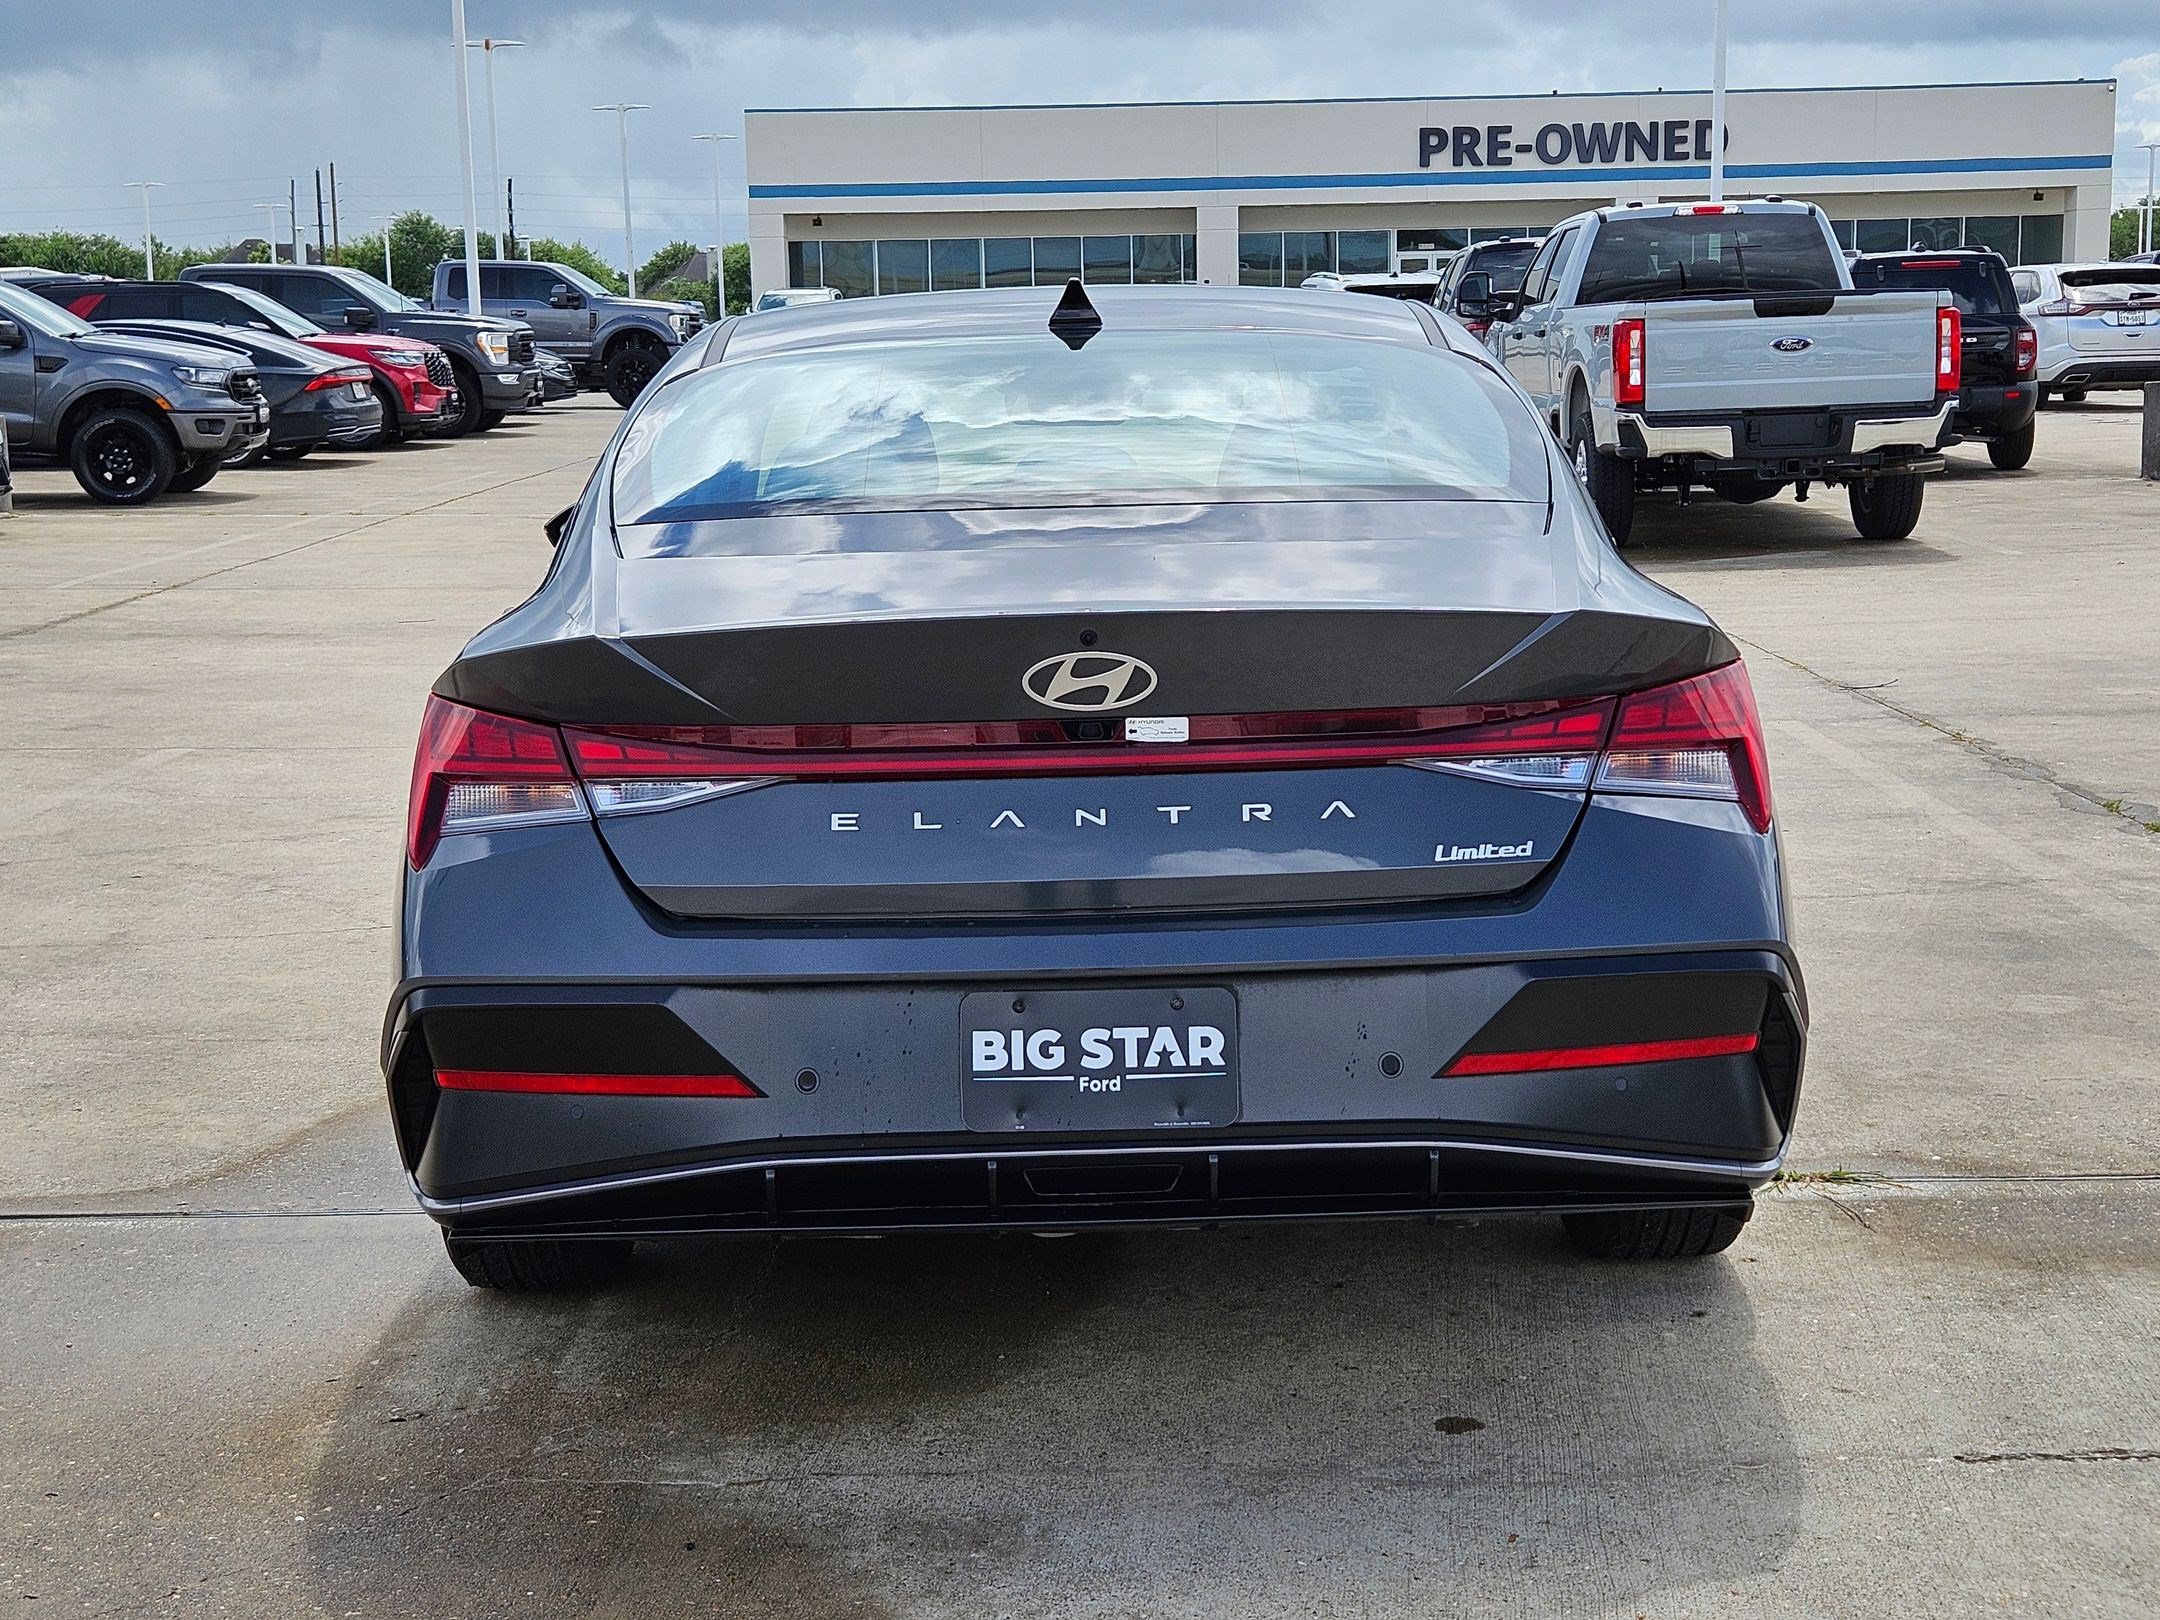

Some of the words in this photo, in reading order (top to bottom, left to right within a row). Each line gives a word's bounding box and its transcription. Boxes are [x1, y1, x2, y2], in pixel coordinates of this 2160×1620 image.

[1419, 119, 1729, 168] PRE-OWNED
[830, 800, 1356, 831] ELANTRA
[1434, 840, 1534, 862] Limited
[972, 1029, 1066, 1072] BIG
[1080, 1026, 1226, 1071] STAR
[1079, 1074, 1121, 1093] Ford
